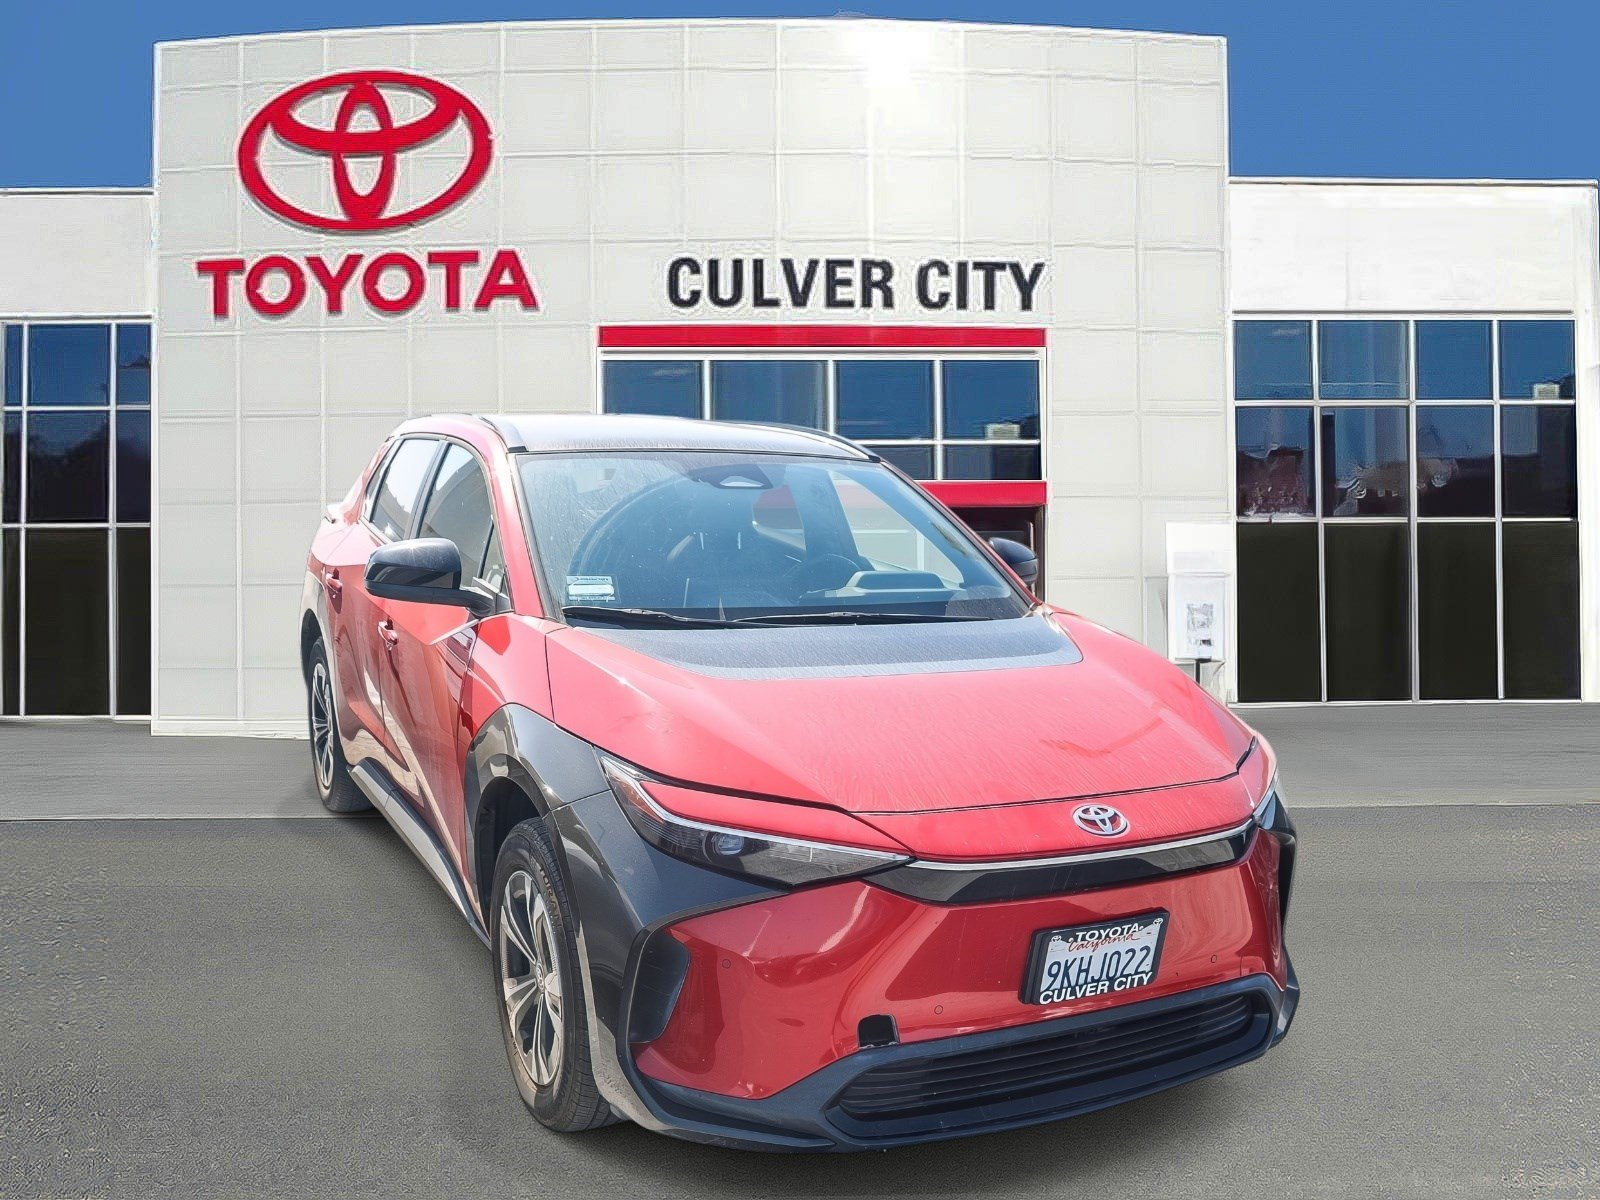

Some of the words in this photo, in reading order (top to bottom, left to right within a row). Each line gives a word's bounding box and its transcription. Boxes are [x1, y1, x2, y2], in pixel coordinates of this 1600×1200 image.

[196, 250, 538, 317] TOYOTA
[667, 257, 894, 309] CULVER
[915, 259, 1045, 311] CITY
[1068, 932, 1140, 952] California
[1075, 922, 1139, 942] TOYOTA
[1046, 945, 1151, 990] 9KHJ022
[1039, 981, 1108, 1005] CULVER
[1114, 971, 1153, 991] CITY
